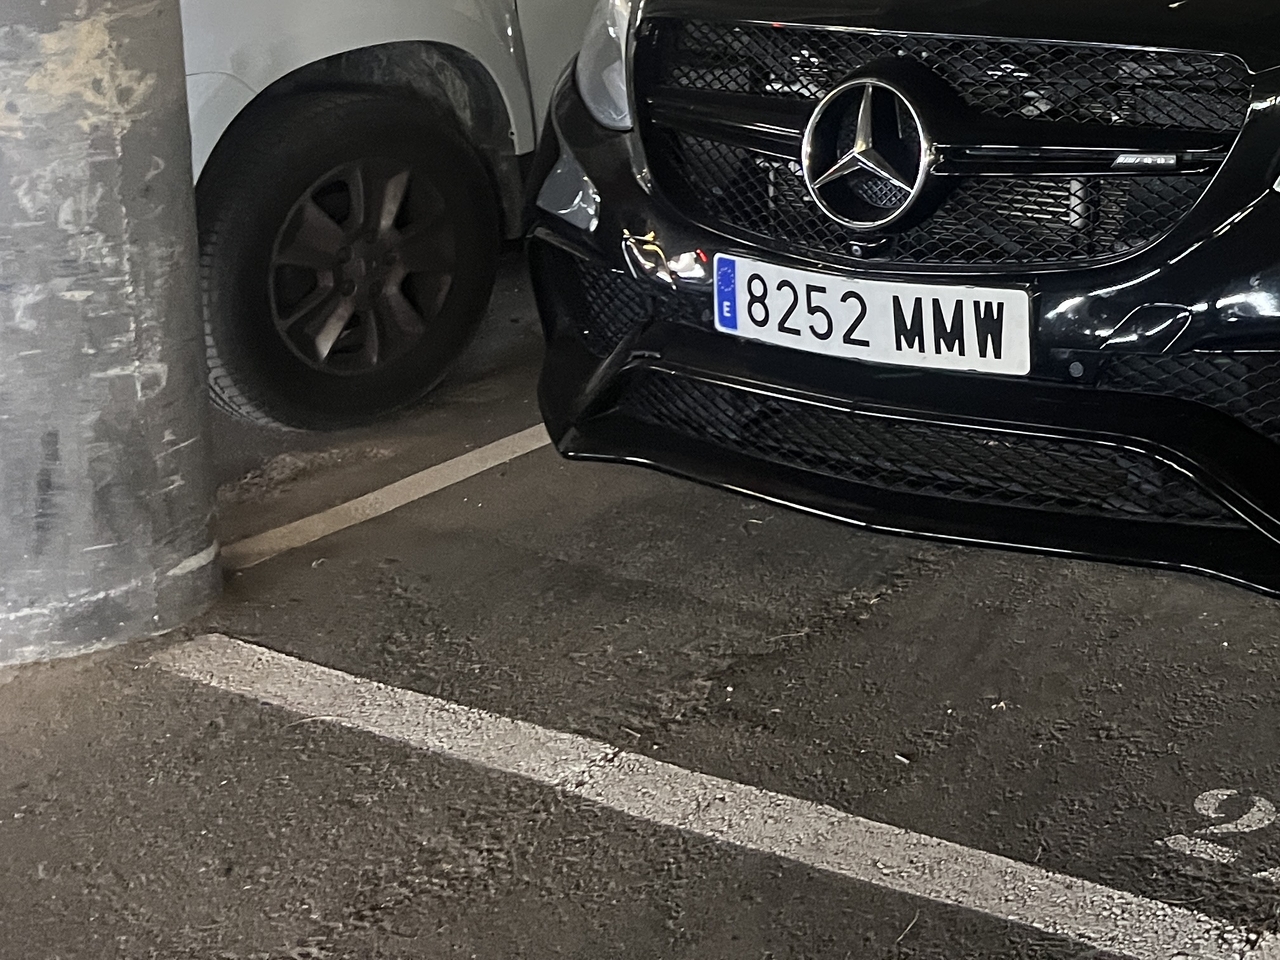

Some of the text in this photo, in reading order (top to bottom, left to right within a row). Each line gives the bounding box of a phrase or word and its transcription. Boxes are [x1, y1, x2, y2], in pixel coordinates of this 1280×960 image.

[722, 301, 731, 317] E
[746, 272, 1005, 360] 8252 MMW
